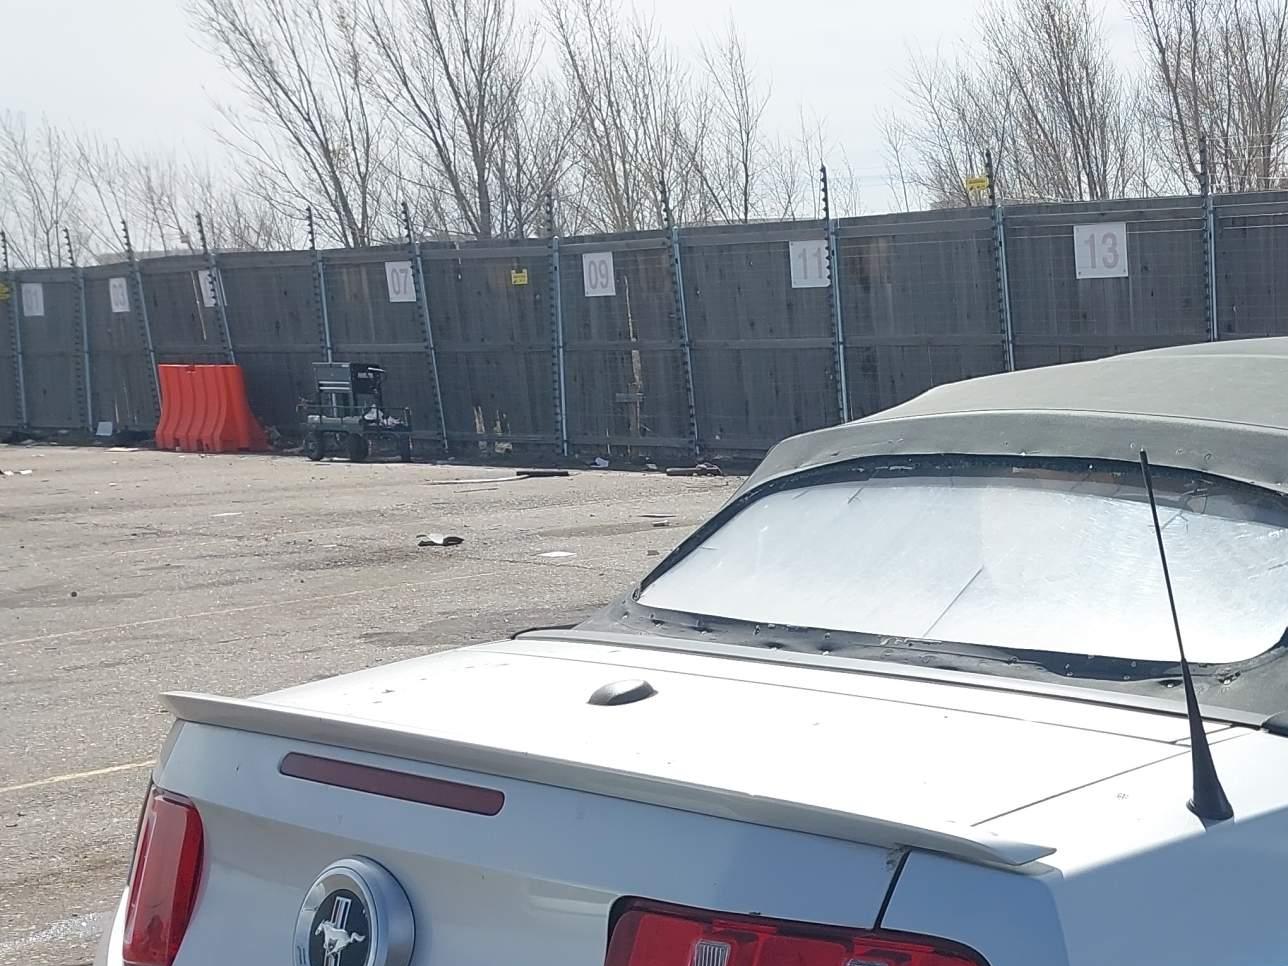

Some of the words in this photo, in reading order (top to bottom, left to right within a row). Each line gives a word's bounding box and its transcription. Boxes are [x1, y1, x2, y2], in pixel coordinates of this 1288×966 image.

[798, 248, 823, 280] 11
[1084, 232, 1119, 269] 13
[391, 268, 409, 296] 07
[586, 259, 609, 290] 09
